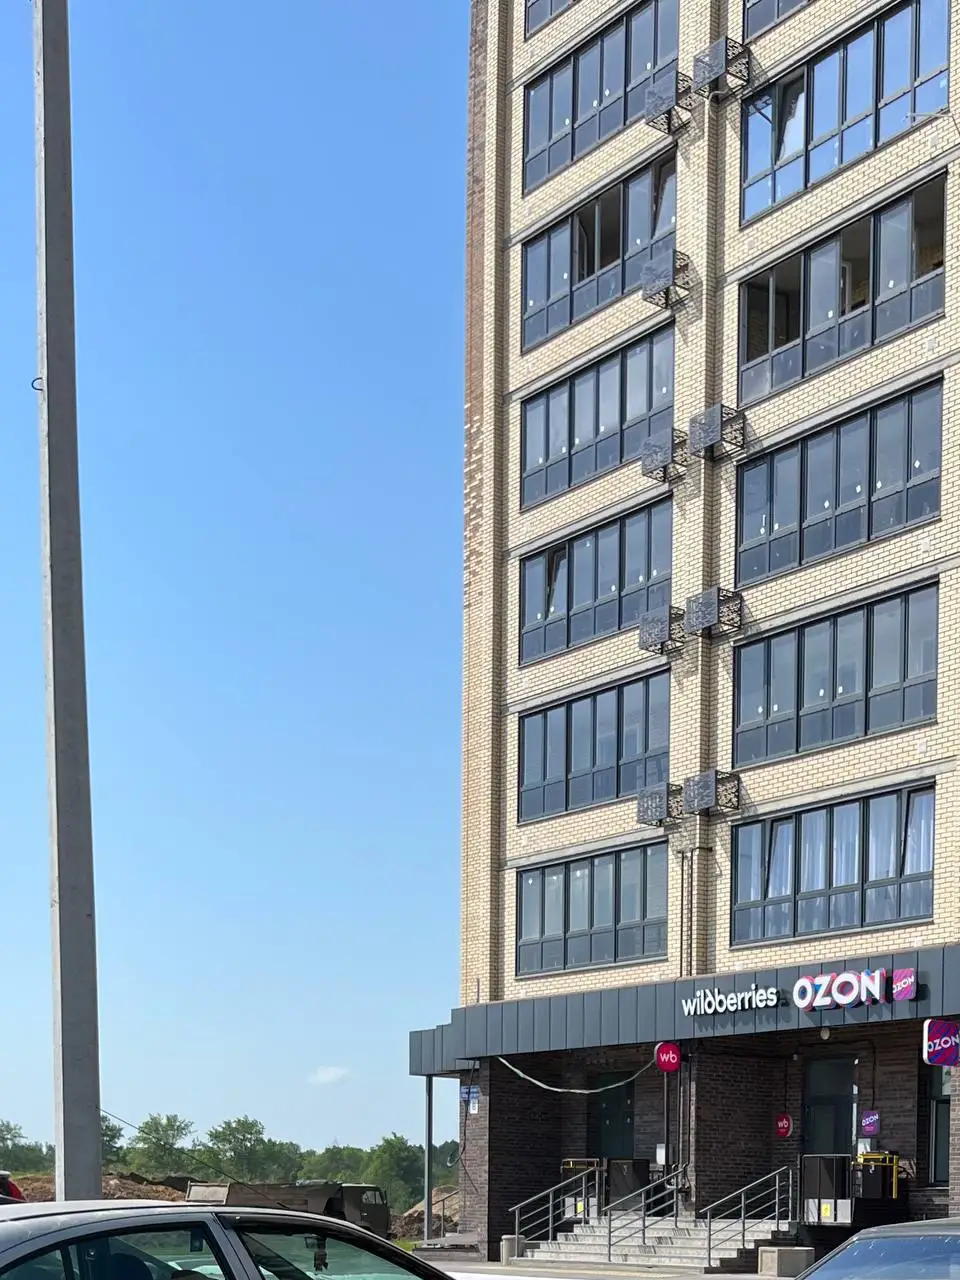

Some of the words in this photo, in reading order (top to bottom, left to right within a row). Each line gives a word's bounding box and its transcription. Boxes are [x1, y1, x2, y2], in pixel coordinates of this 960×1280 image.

[682, 983, 777, 1016] wildberries
[793, 968, 883, 1010] OZON
[927, 1034, 960, 1052] OZON
[660, 1050, 678, 1063] wb
